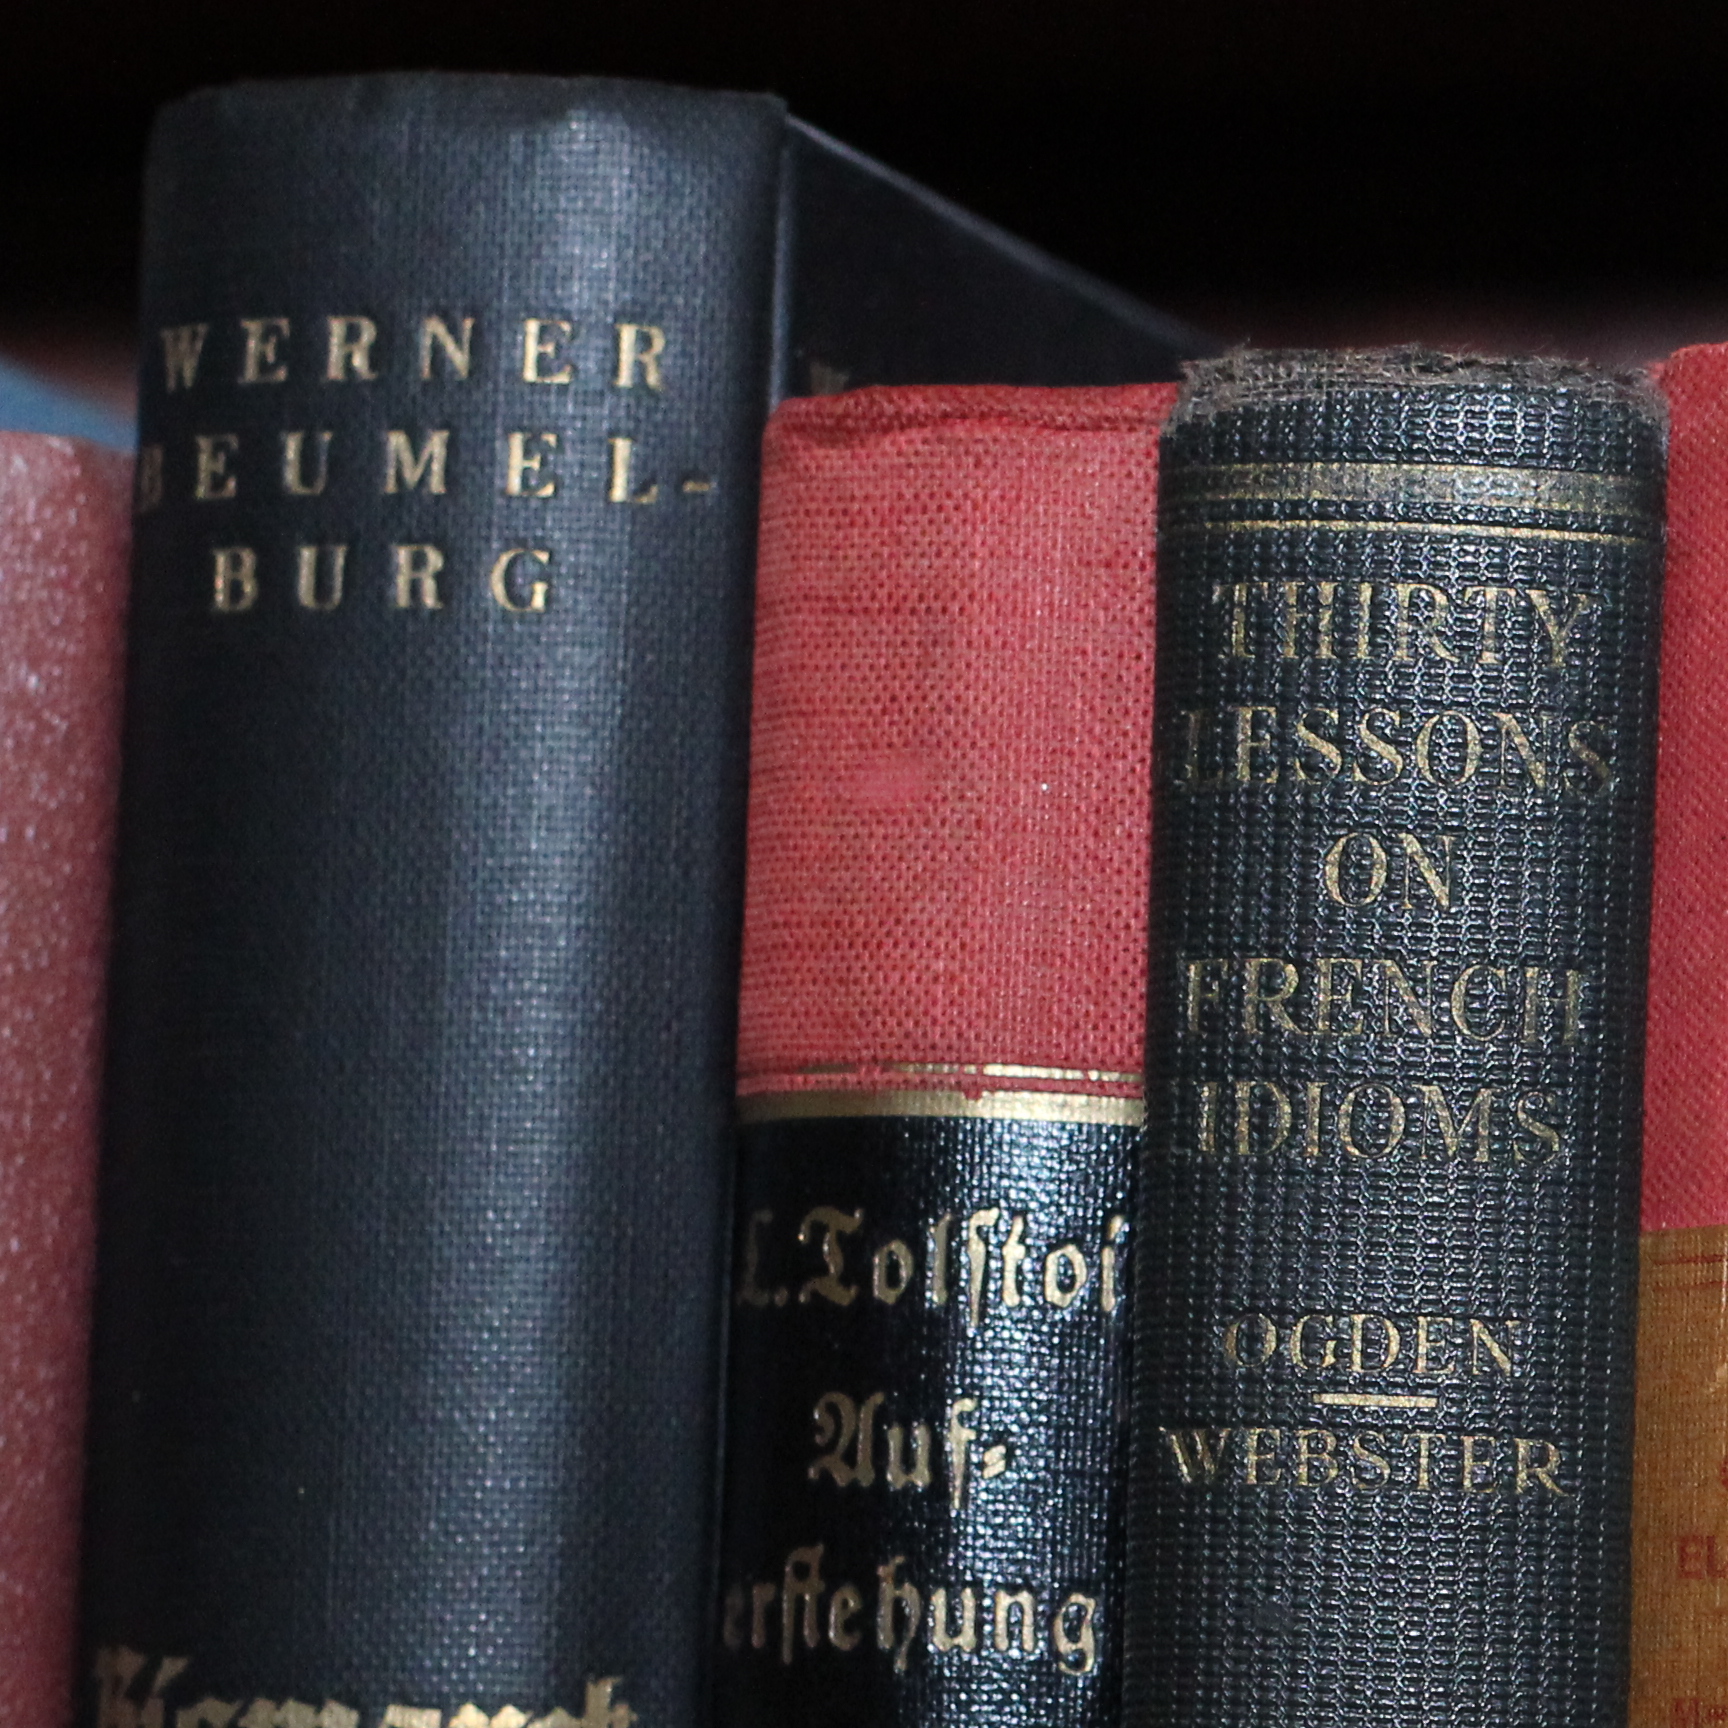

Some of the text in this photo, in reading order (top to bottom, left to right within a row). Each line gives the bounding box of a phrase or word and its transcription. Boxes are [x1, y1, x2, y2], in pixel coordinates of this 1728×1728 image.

[160, 312, 667, 394] WERNER
[210, 542, 552, 614] BURG
[1211, 580, 1599, 668] THIRTY
[1178, 704, 1618, 797] LESSONS
[1324, 830, 1457, 910] ON
[1176, 956, 1592, 1048] FRENCH
[1197, 1079, 1563, 1165] IDIOMS
[1222, 1312, 1524, 1377] OGDEN
[1159, 1424, 1570, 1498] WEBSTER
